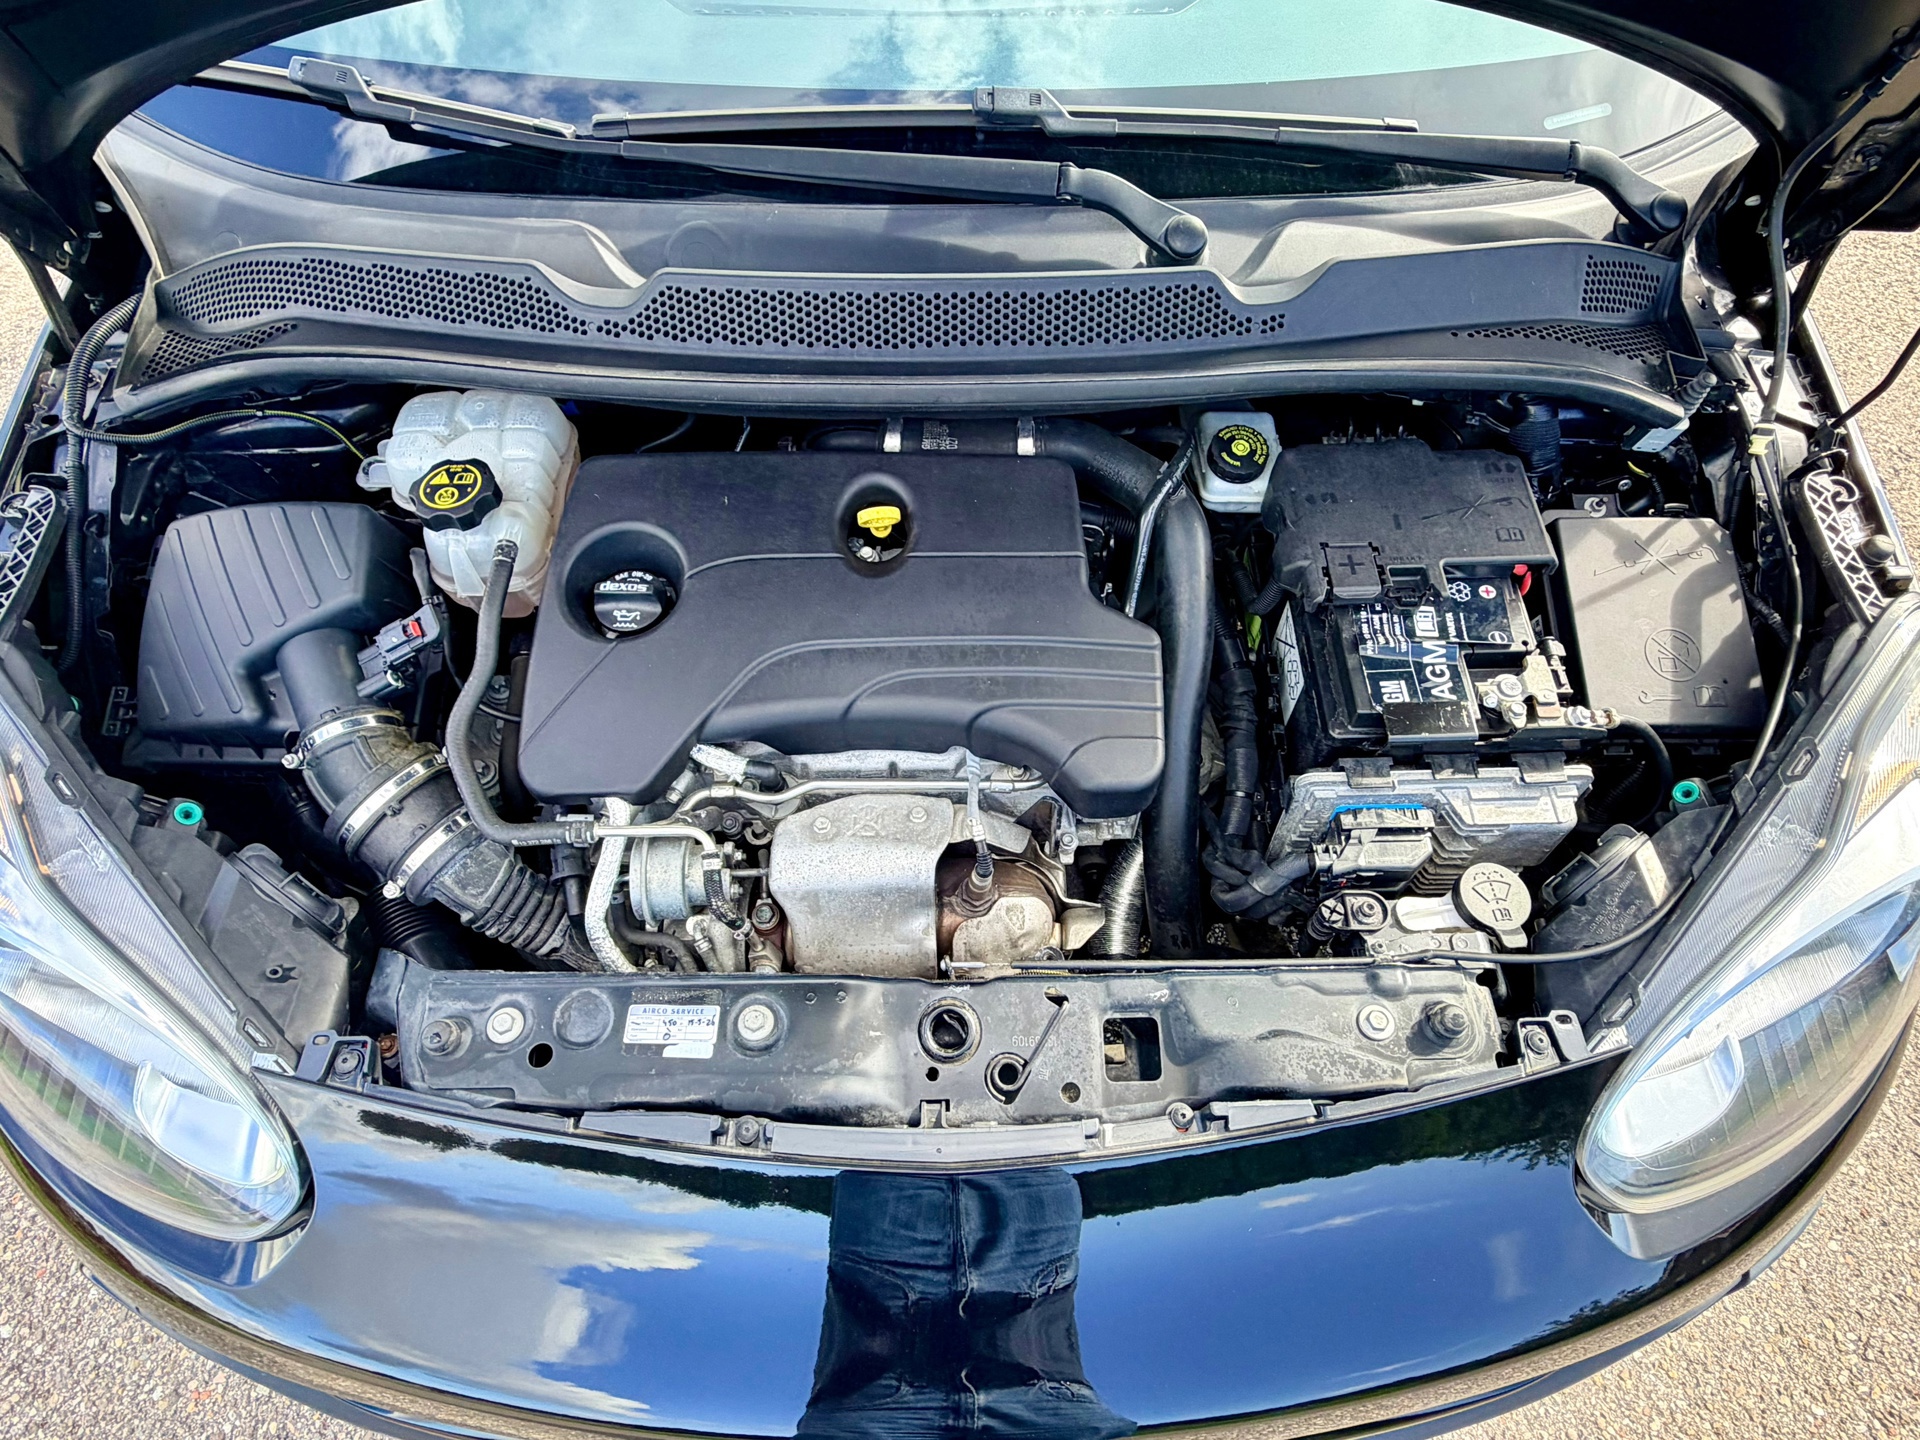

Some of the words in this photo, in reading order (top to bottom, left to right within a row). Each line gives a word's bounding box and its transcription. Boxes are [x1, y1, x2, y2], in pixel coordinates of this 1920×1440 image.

[599, 580, 650, 592] dexos
[1445, 612, 1457, 637] VARTA
[1423, 640, 1458, 701] AGM
[1379, 680, 1404, 703] GM
[642, 1007, 668, 1015] AIRCO
